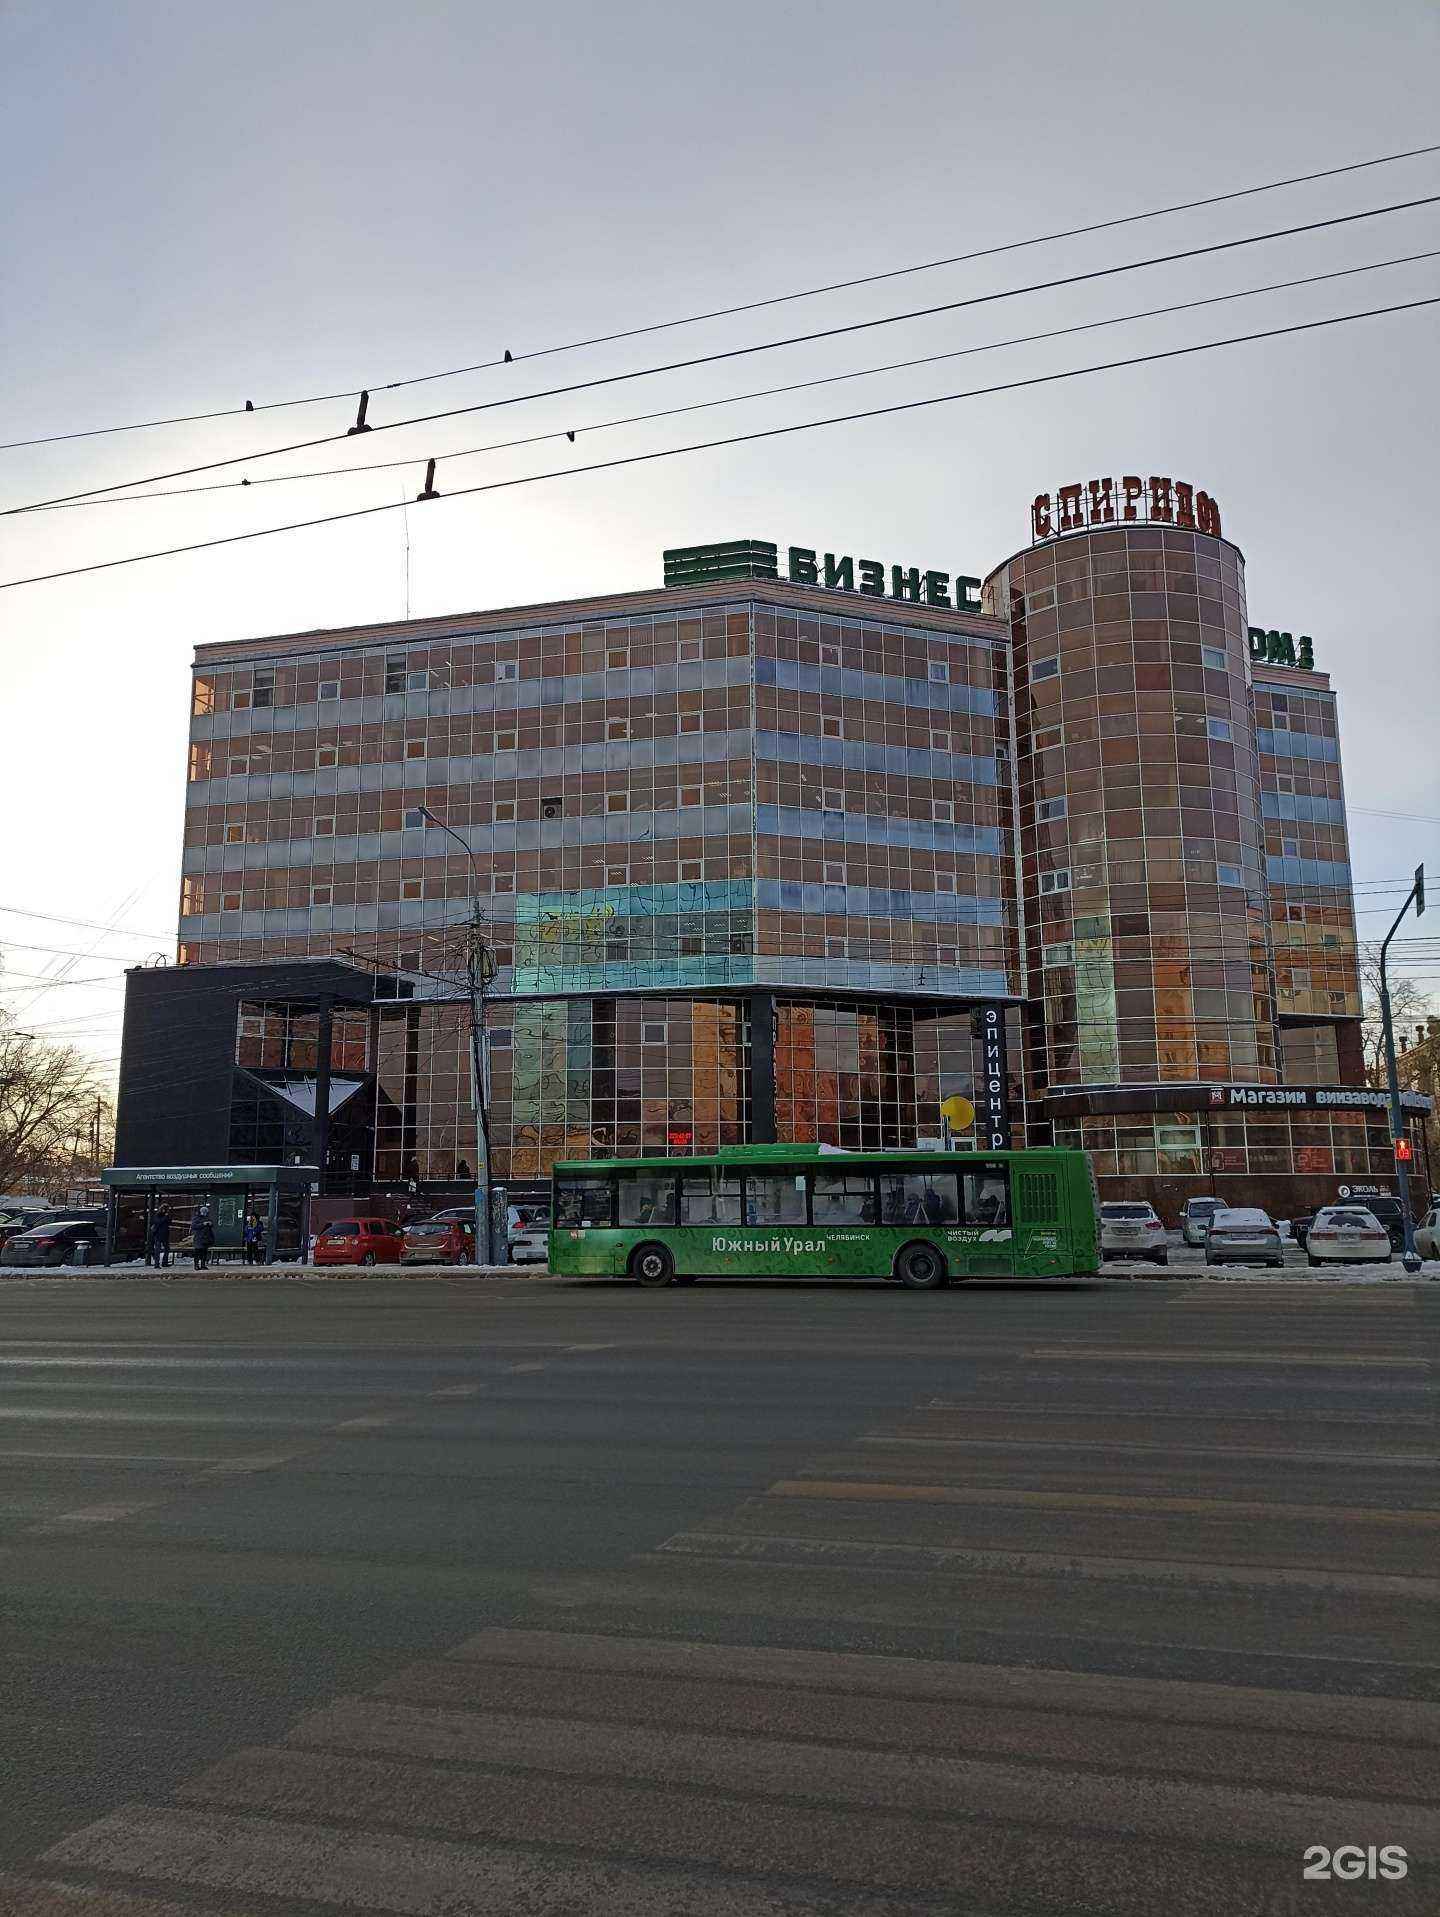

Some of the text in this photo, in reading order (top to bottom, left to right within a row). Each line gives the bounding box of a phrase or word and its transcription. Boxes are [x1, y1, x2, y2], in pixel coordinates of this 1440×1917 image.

[789, 546, 981, 613] БИЗНЕС
[1230, 1089, 1307, 1104] Магазин
[712, 1237, 826, 1255] Южный Урал
